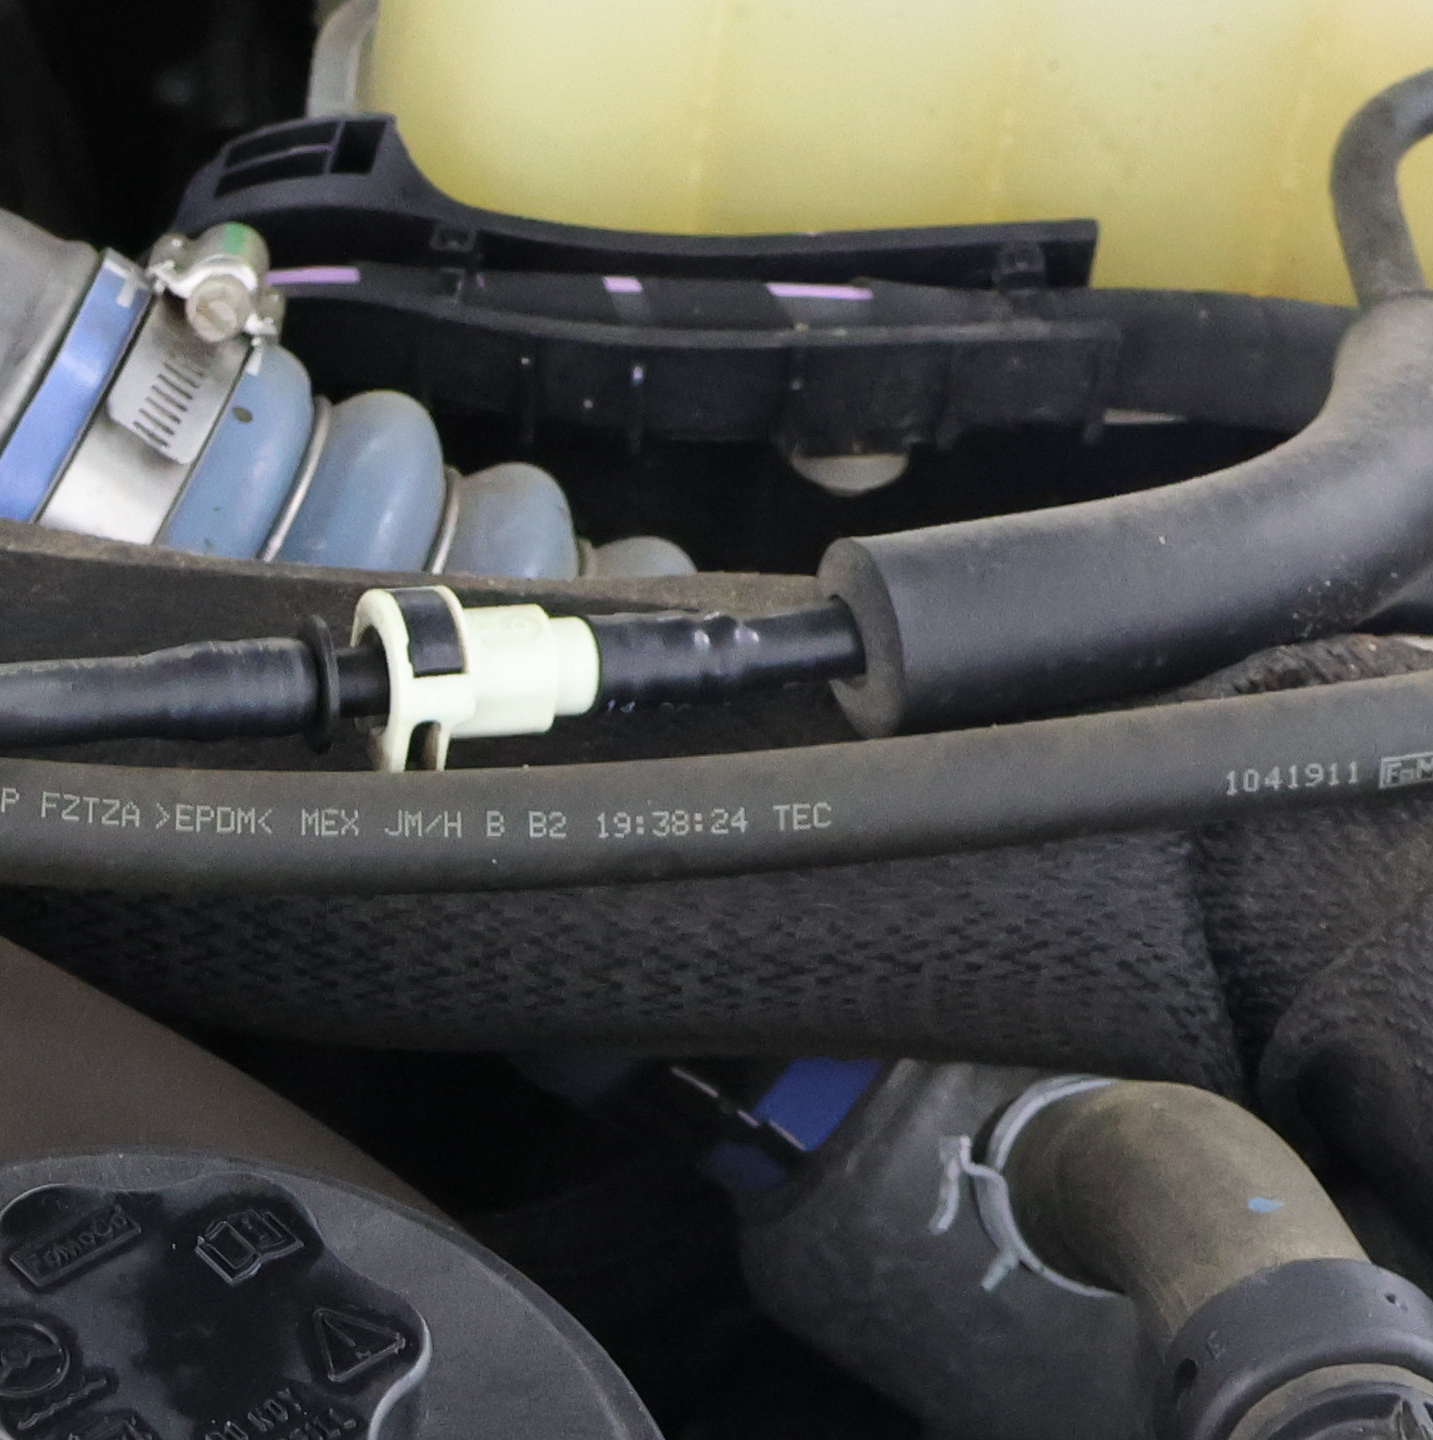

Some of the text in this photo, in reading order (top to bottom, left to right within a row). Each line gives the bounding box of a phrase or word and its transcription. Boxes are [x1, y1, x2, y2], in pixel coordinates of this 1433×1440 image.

[300, 808, 360, 838] MEX
[384, 809, 463, 839] JM/H
[486, 810, 505, 838] B
[528, 810, 567, 839] B2
[595, 807, 749, 839] 19:38:24
[772, 802, 832, 832] TEC
[1225, 761, 1359, 796] 1041911
